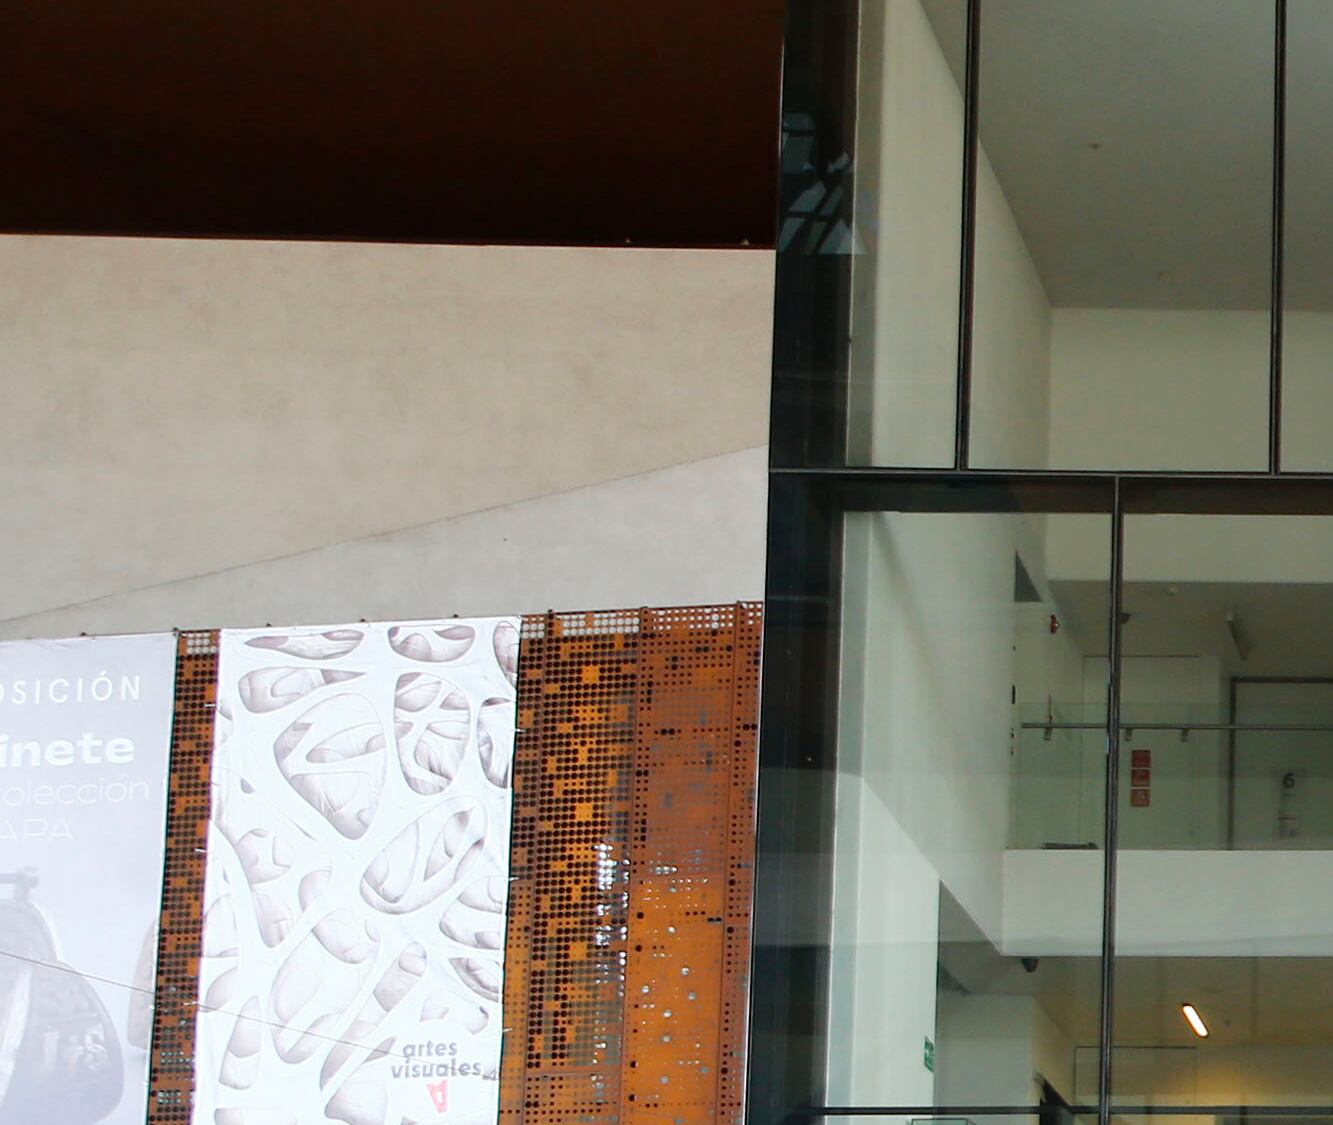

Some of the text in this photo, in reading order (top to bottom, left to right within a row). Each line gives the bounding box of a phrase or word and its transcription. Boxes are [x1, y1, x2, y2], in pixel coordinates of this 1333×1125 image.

[0, 670, 141, 705] SICIÓN
[402, 1041, 457, 1059] artes
[391, 1058, 480, 1079] visuales
